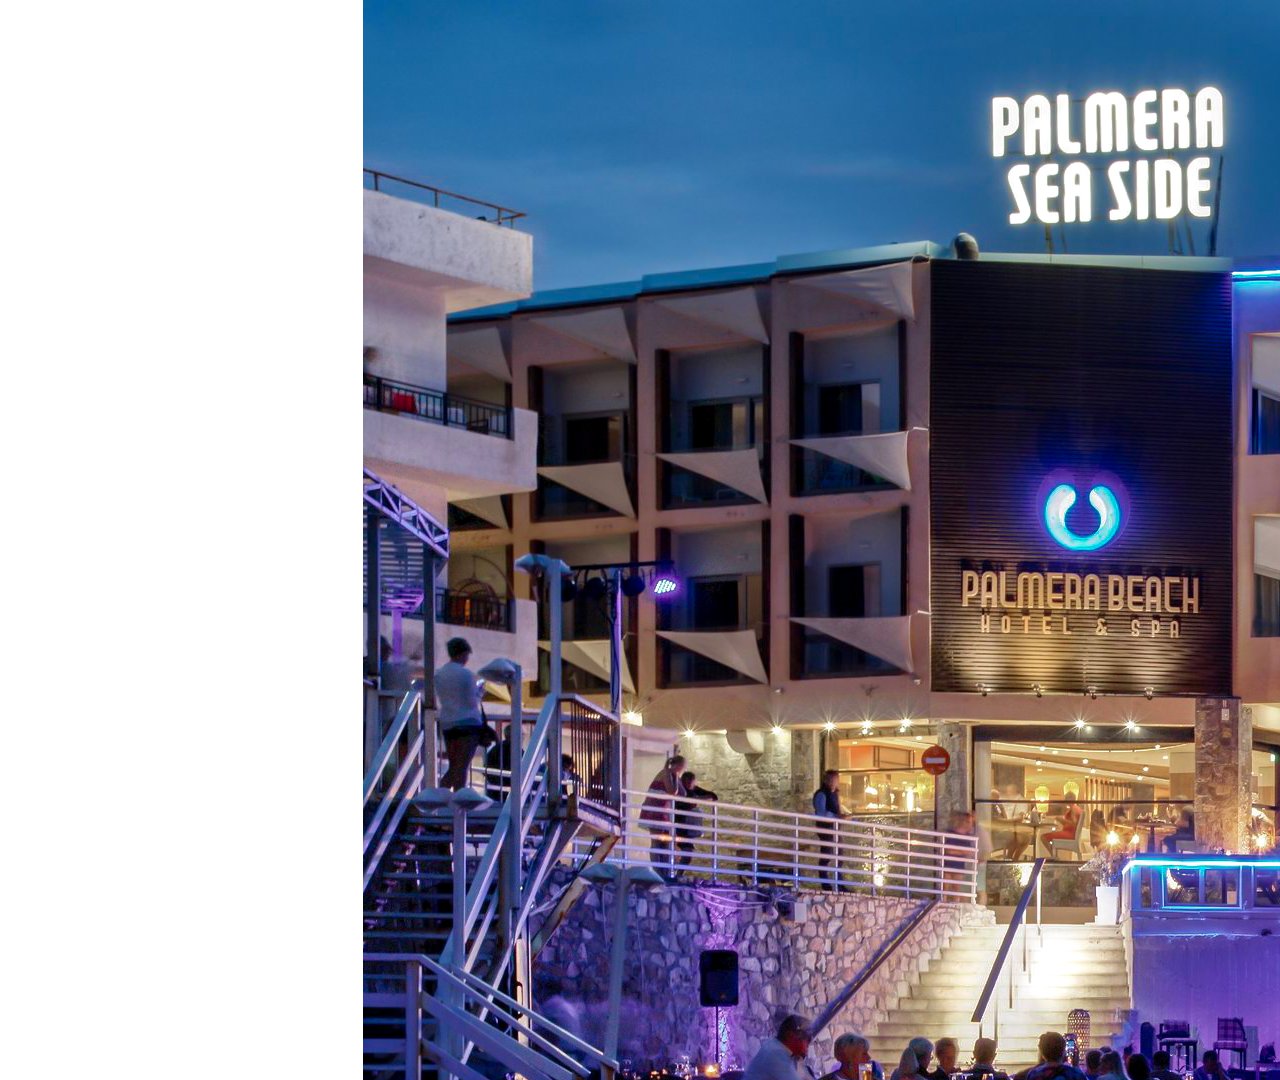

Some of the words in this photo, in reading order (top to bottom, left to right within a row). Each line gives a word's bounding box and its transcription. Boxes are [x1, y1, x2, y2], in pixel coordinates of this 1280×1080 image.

[992, 86, 1224, 157] PALMERA
[1007, 161, 1091, 225] SEA
[1108, 157, 1211, 221] SIDE
[962, 570, 1100, 610] PALMERA
[1108, 574, 1199, 614] BEACH
[980, 615, 1072, 635] HOTEL
[1095, 617, 1108, 636] &
[1131, 619, 1179, 639] SPA
